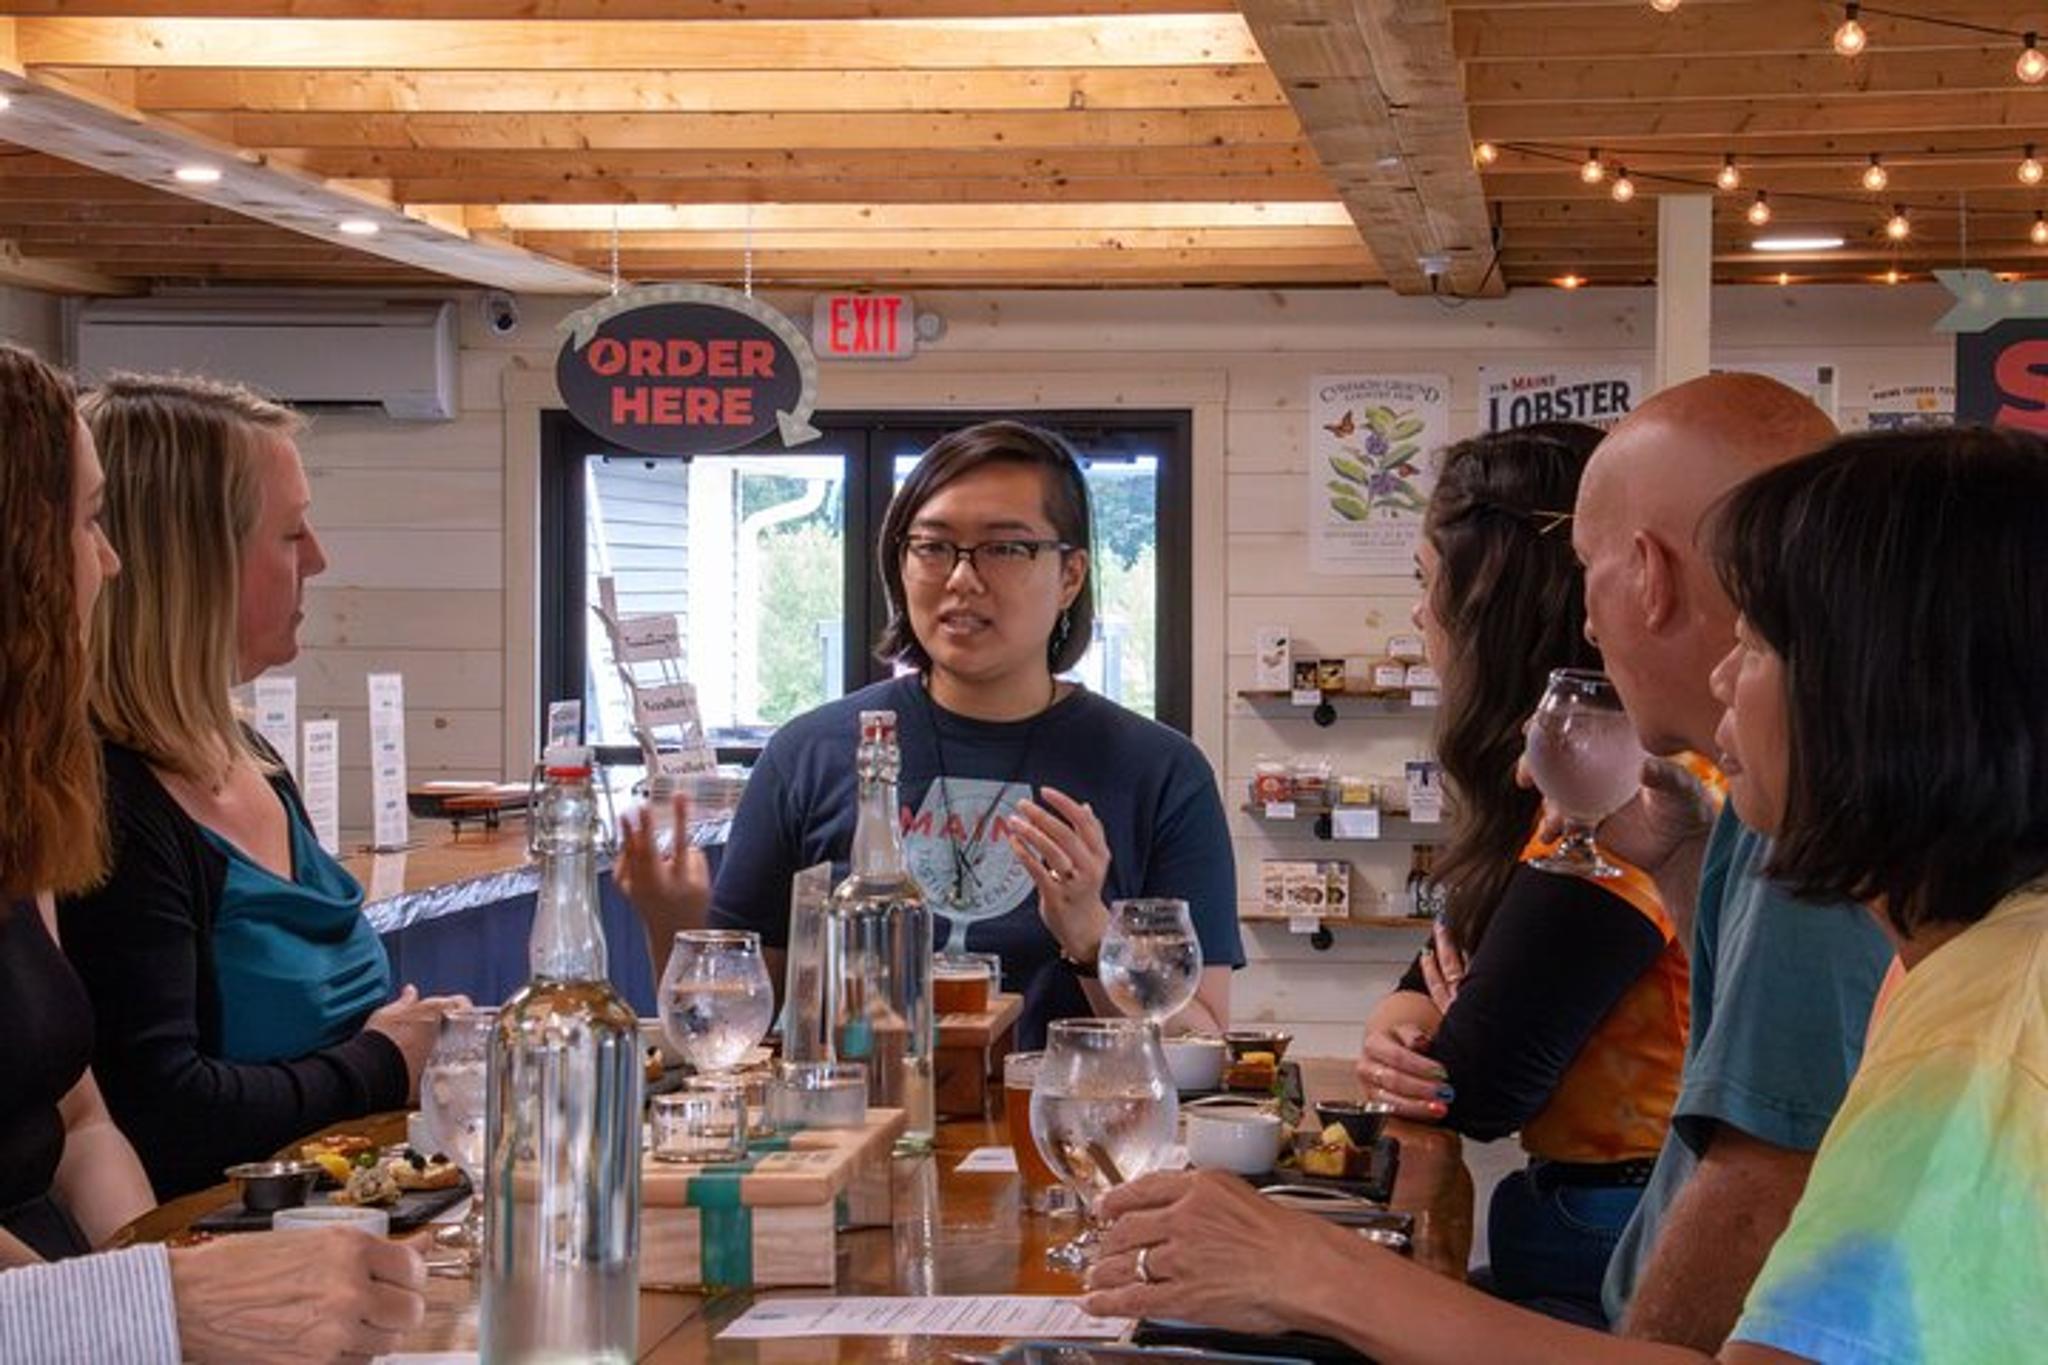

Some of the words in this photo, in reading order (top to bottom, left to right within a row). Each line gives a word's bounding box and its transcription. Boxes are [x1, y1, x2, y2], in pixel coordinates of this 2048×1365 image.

[829, 298, 902, 353] EXIT
[587, 338, 775, 378] ORDER
[1384, 380, 1440, 403] GROUND
[1511, 375, 1556, 394] MAINE
[610, 386, 755, 427] HERE
[1489, 380, 1631, 432] LOBSTER
[900, 803, 1011, 842] MAIN
